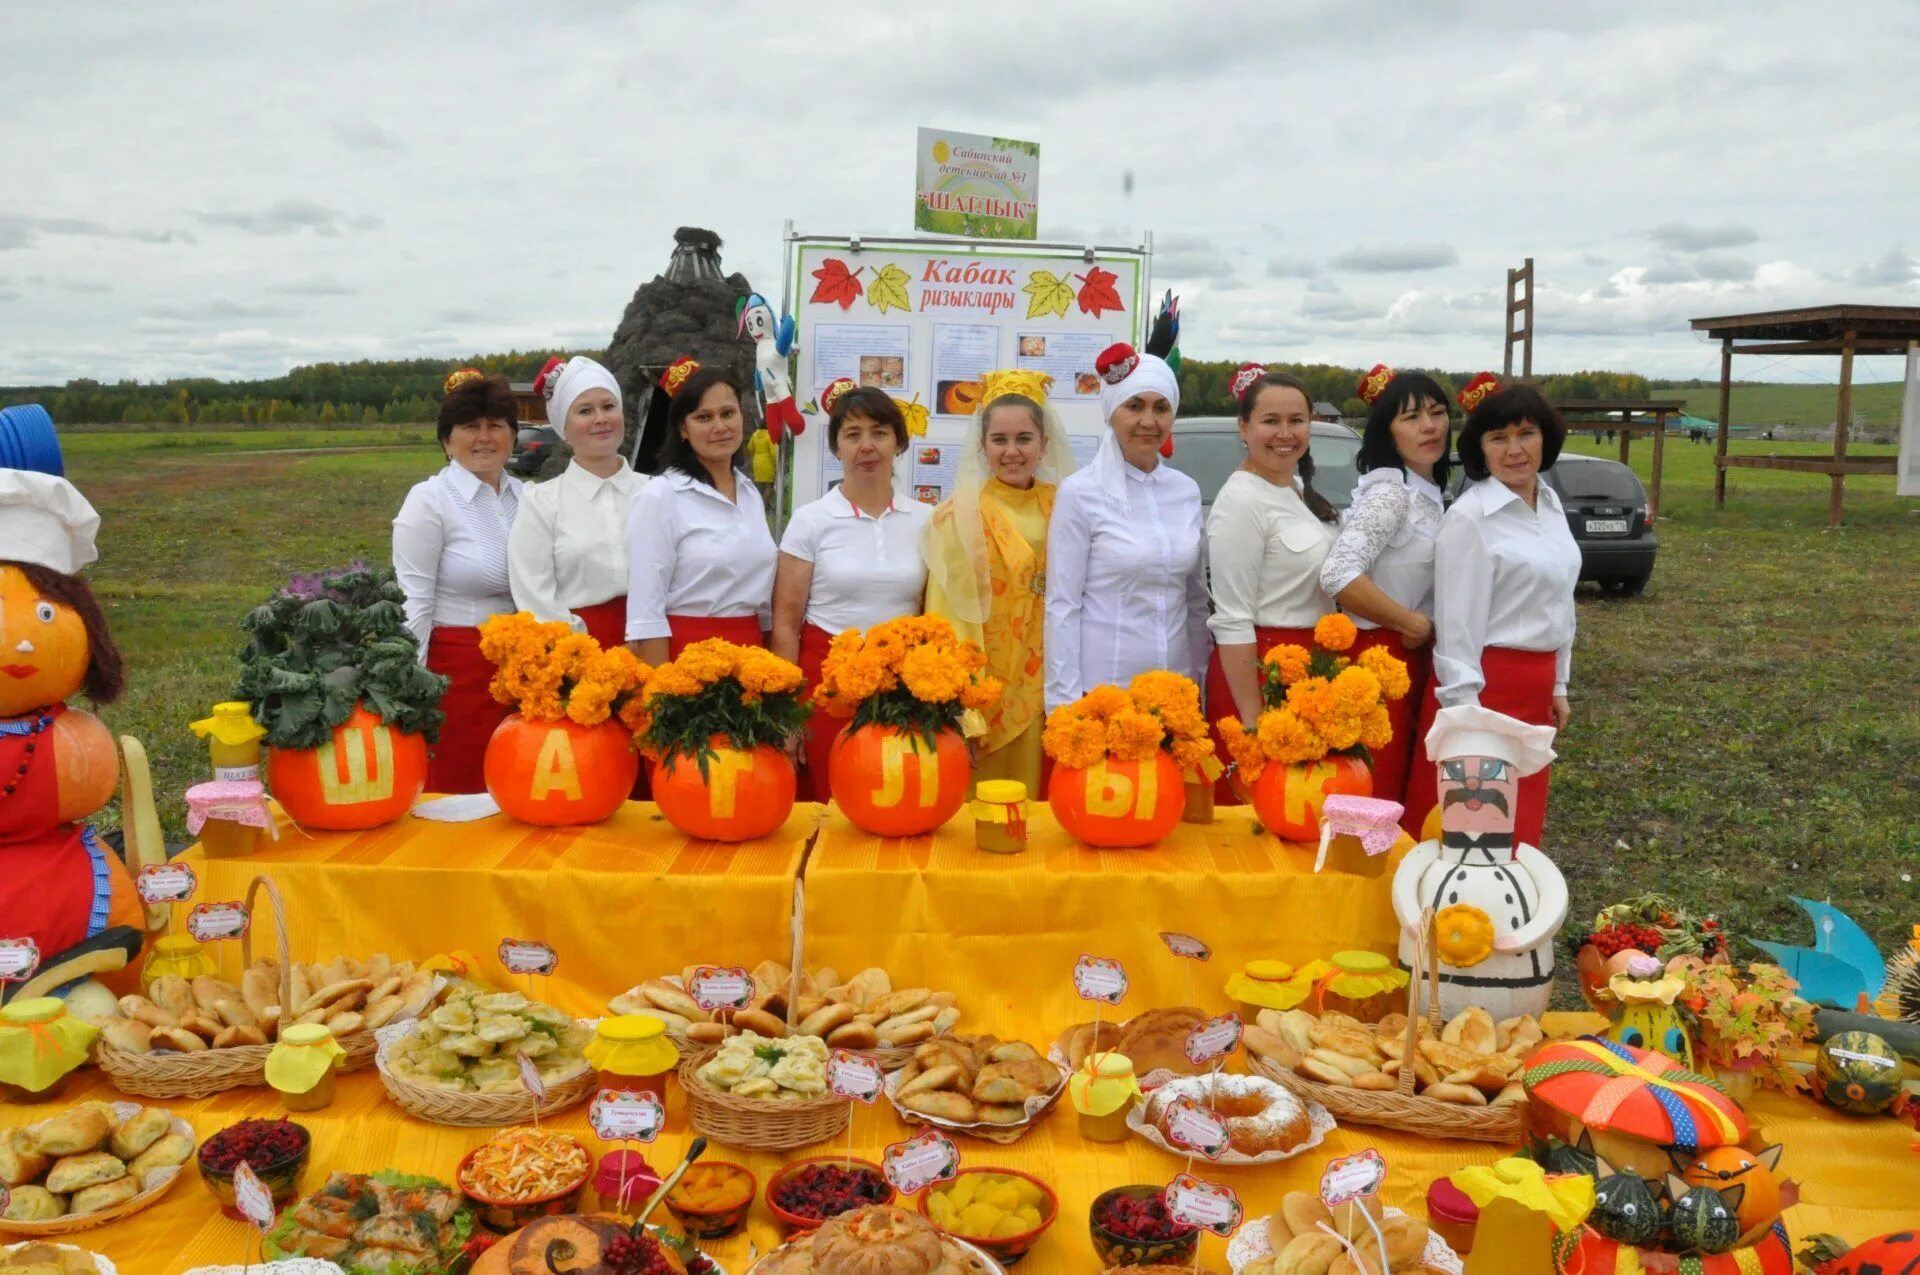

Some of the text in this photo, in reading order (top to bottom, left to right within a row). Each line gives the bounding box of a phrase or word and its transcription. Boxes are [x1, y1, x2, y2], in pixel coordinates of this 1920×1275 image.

[952, 144, 1012, 164] Сабинский
[938, 164, 1026, 183] детский сад №1
[920, 259, 1016, 285] Кабак
[919, 289, 1015, 315] ризыклары
